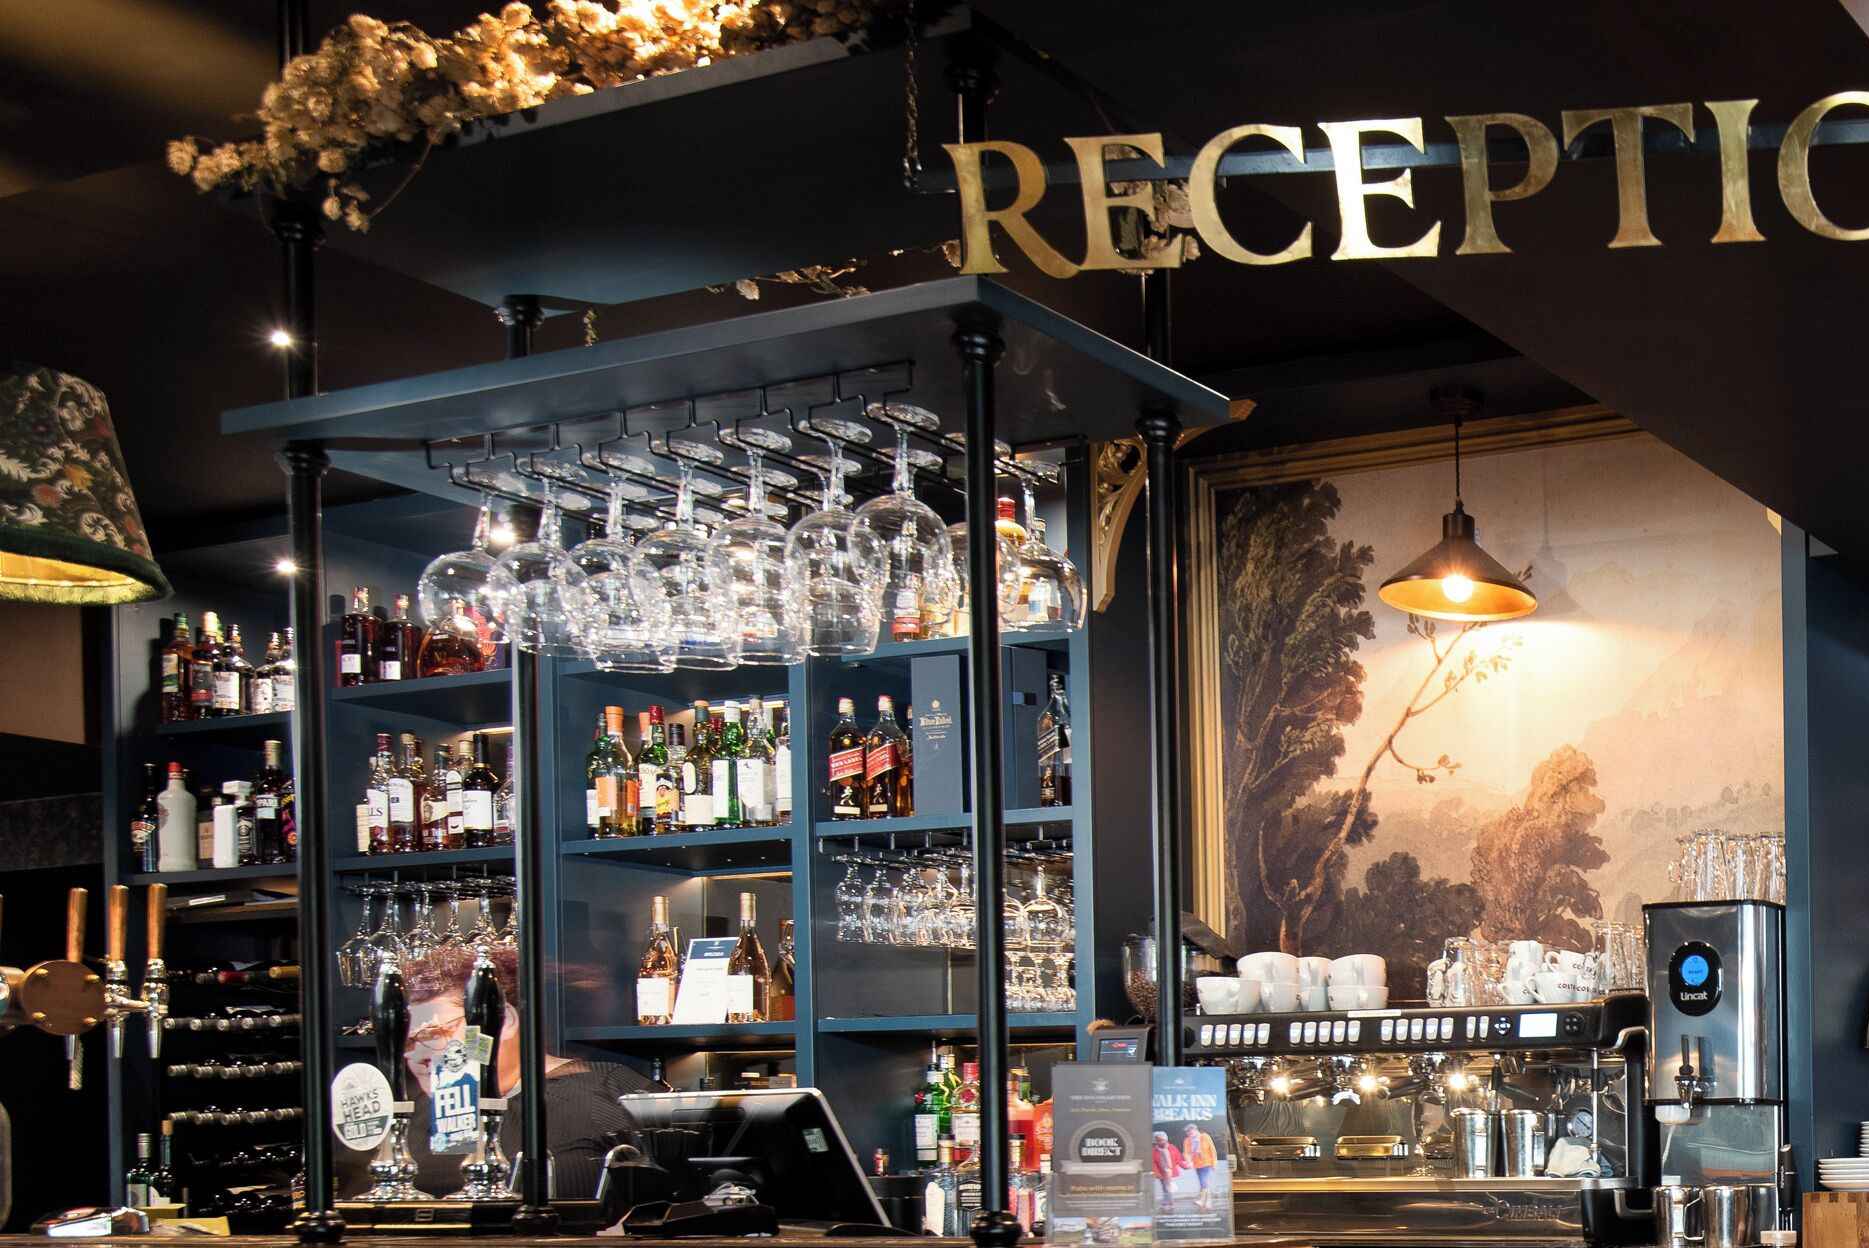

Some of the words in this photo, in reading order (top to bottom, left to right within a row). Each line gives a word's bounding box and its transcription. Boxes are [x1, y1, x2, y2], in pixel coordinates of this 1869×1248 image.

[1680, 991, 1708, 1001] Lincat
[341, 1088, 379, 1109] HAWKS
[434, 1084, 476, 1118] FELL
[343, 1101, 381, 1123] HEAD
[344, 1121, 367, 1140] GOLD
[436, 1113, 477, 1133] WALKER
[1081, 1147, 1122, 1156] DIRECT
[1085, 1138, 1118, 1147] BOOK
